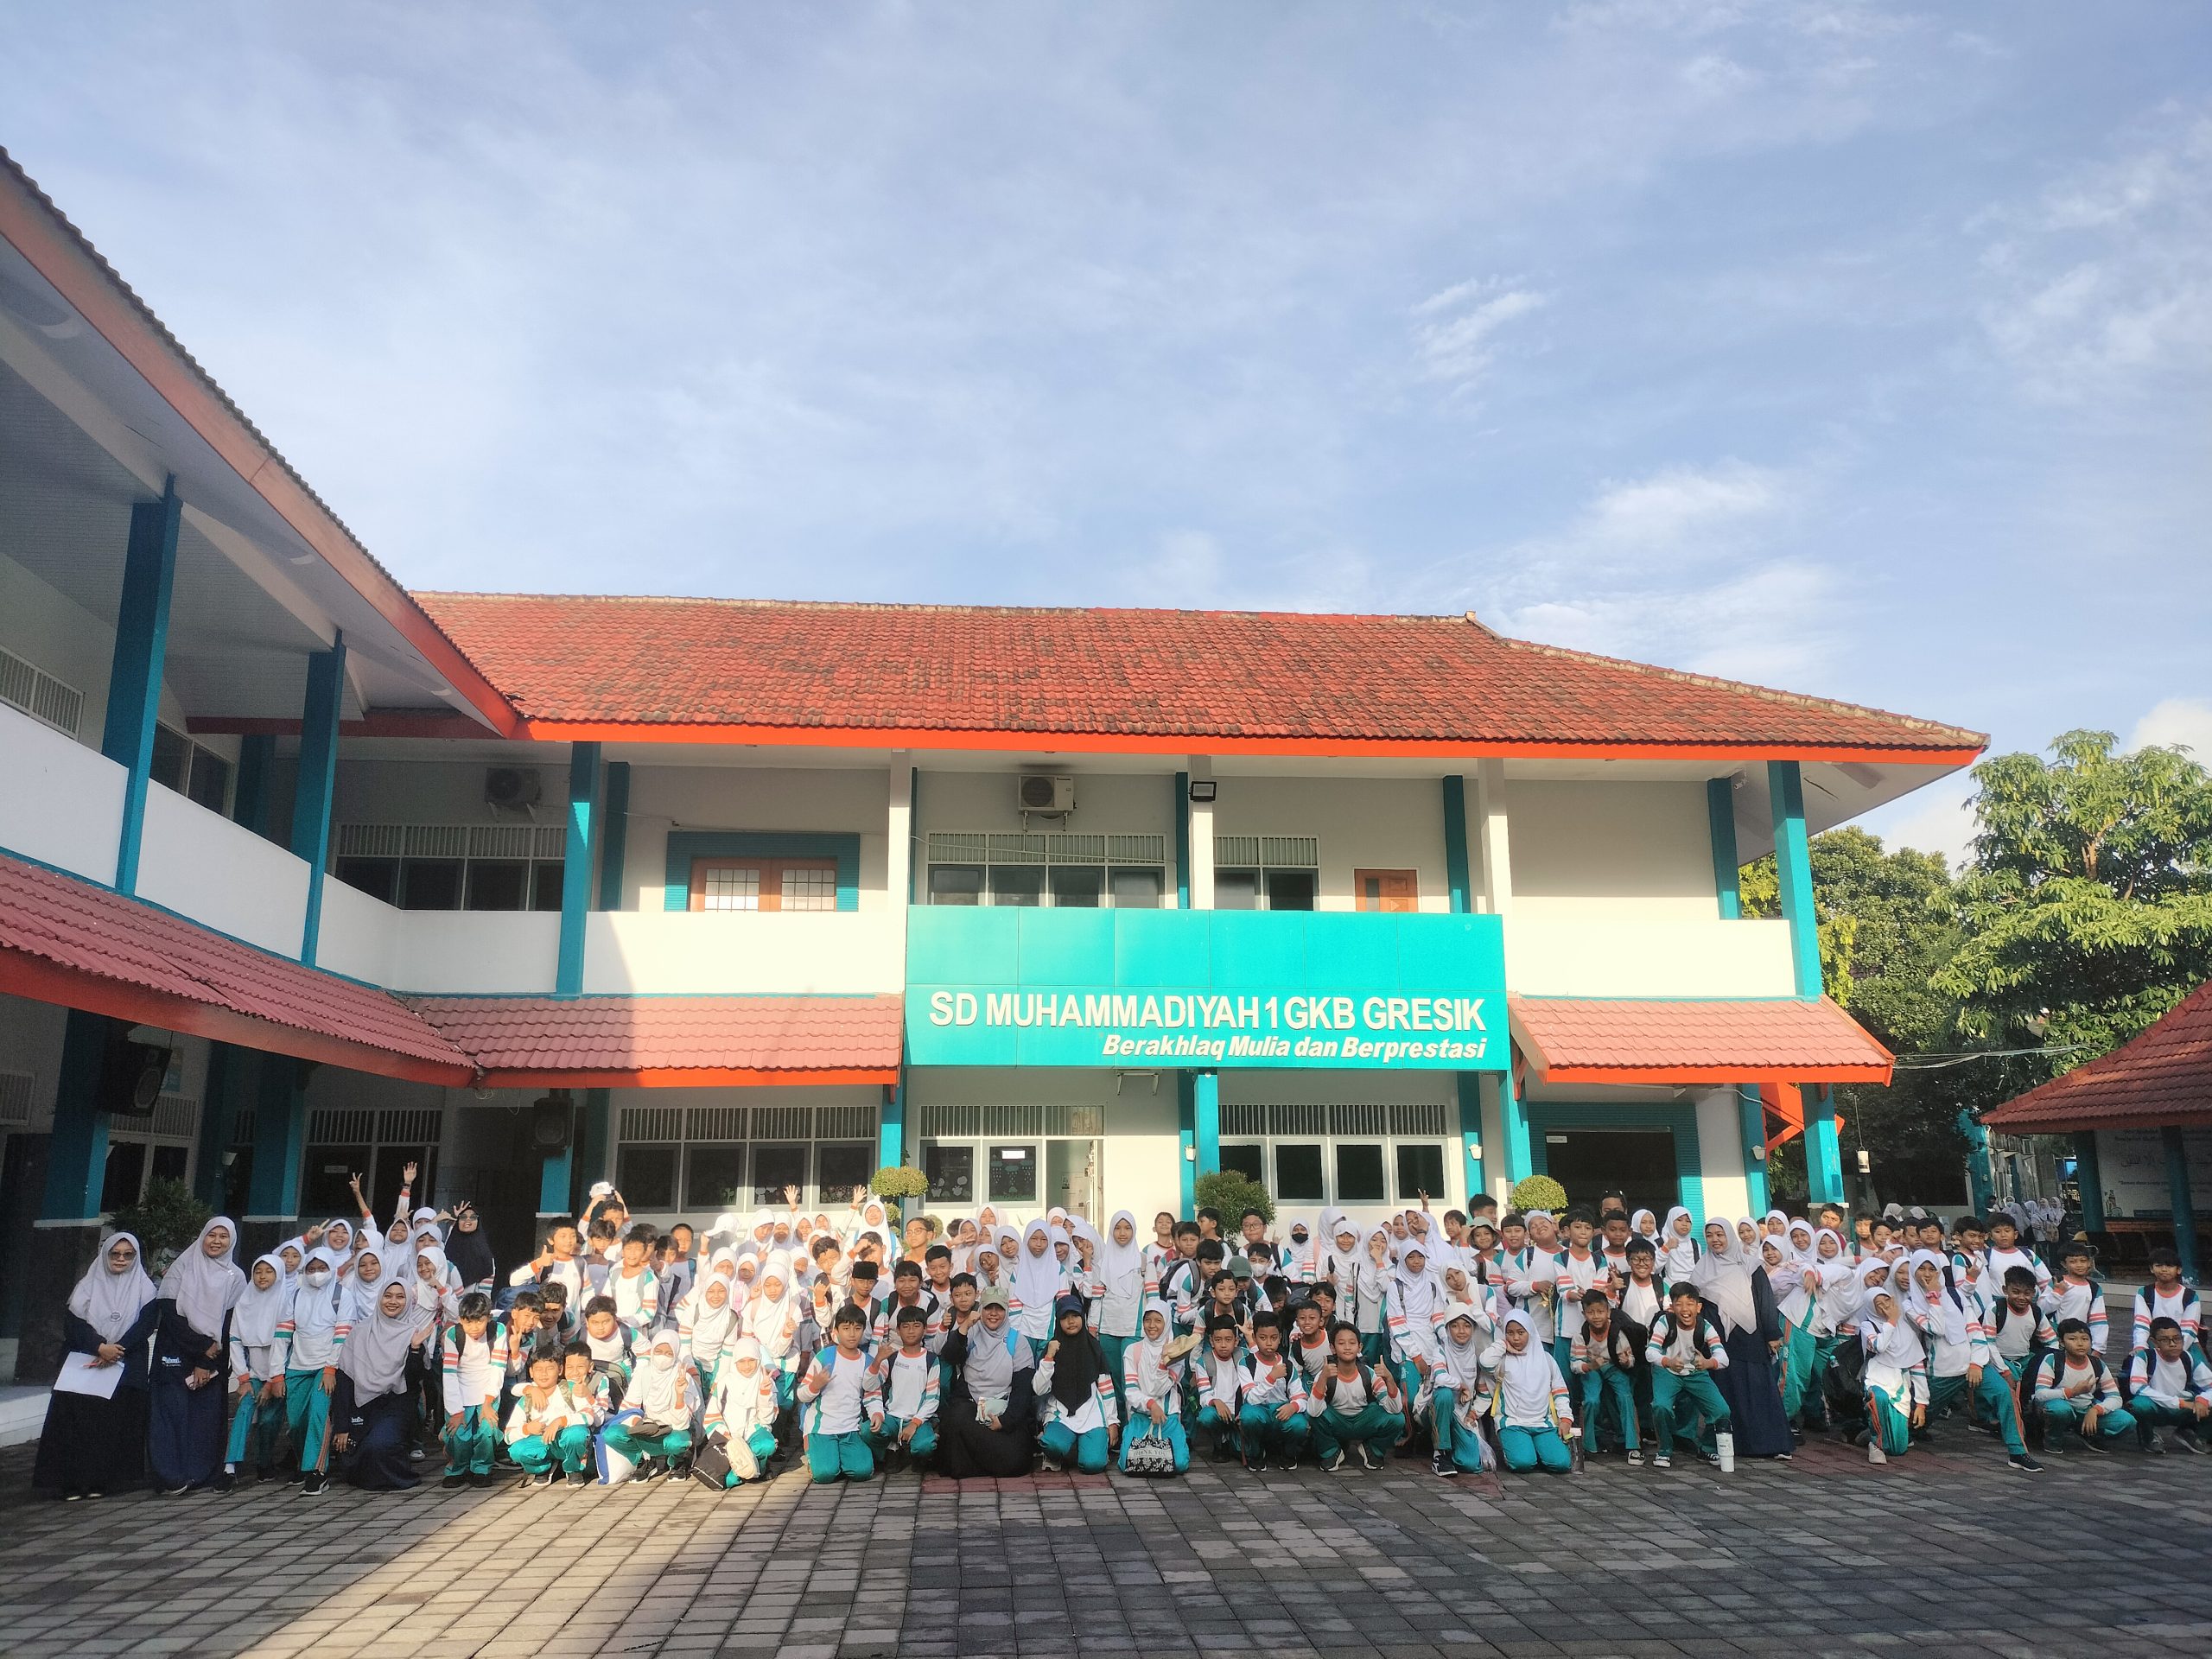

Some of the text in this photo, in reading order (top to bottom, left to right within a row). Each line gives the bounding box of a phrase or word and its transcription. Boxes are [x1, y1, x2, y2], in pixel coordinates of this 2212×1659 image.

[929, 990, 1487, 1032] SD MUHAMMADIYAH 1 GKB GRESIK
[1102, 1033, 1487, 1064] Berakhlaq Mulia dan Berprestasi
